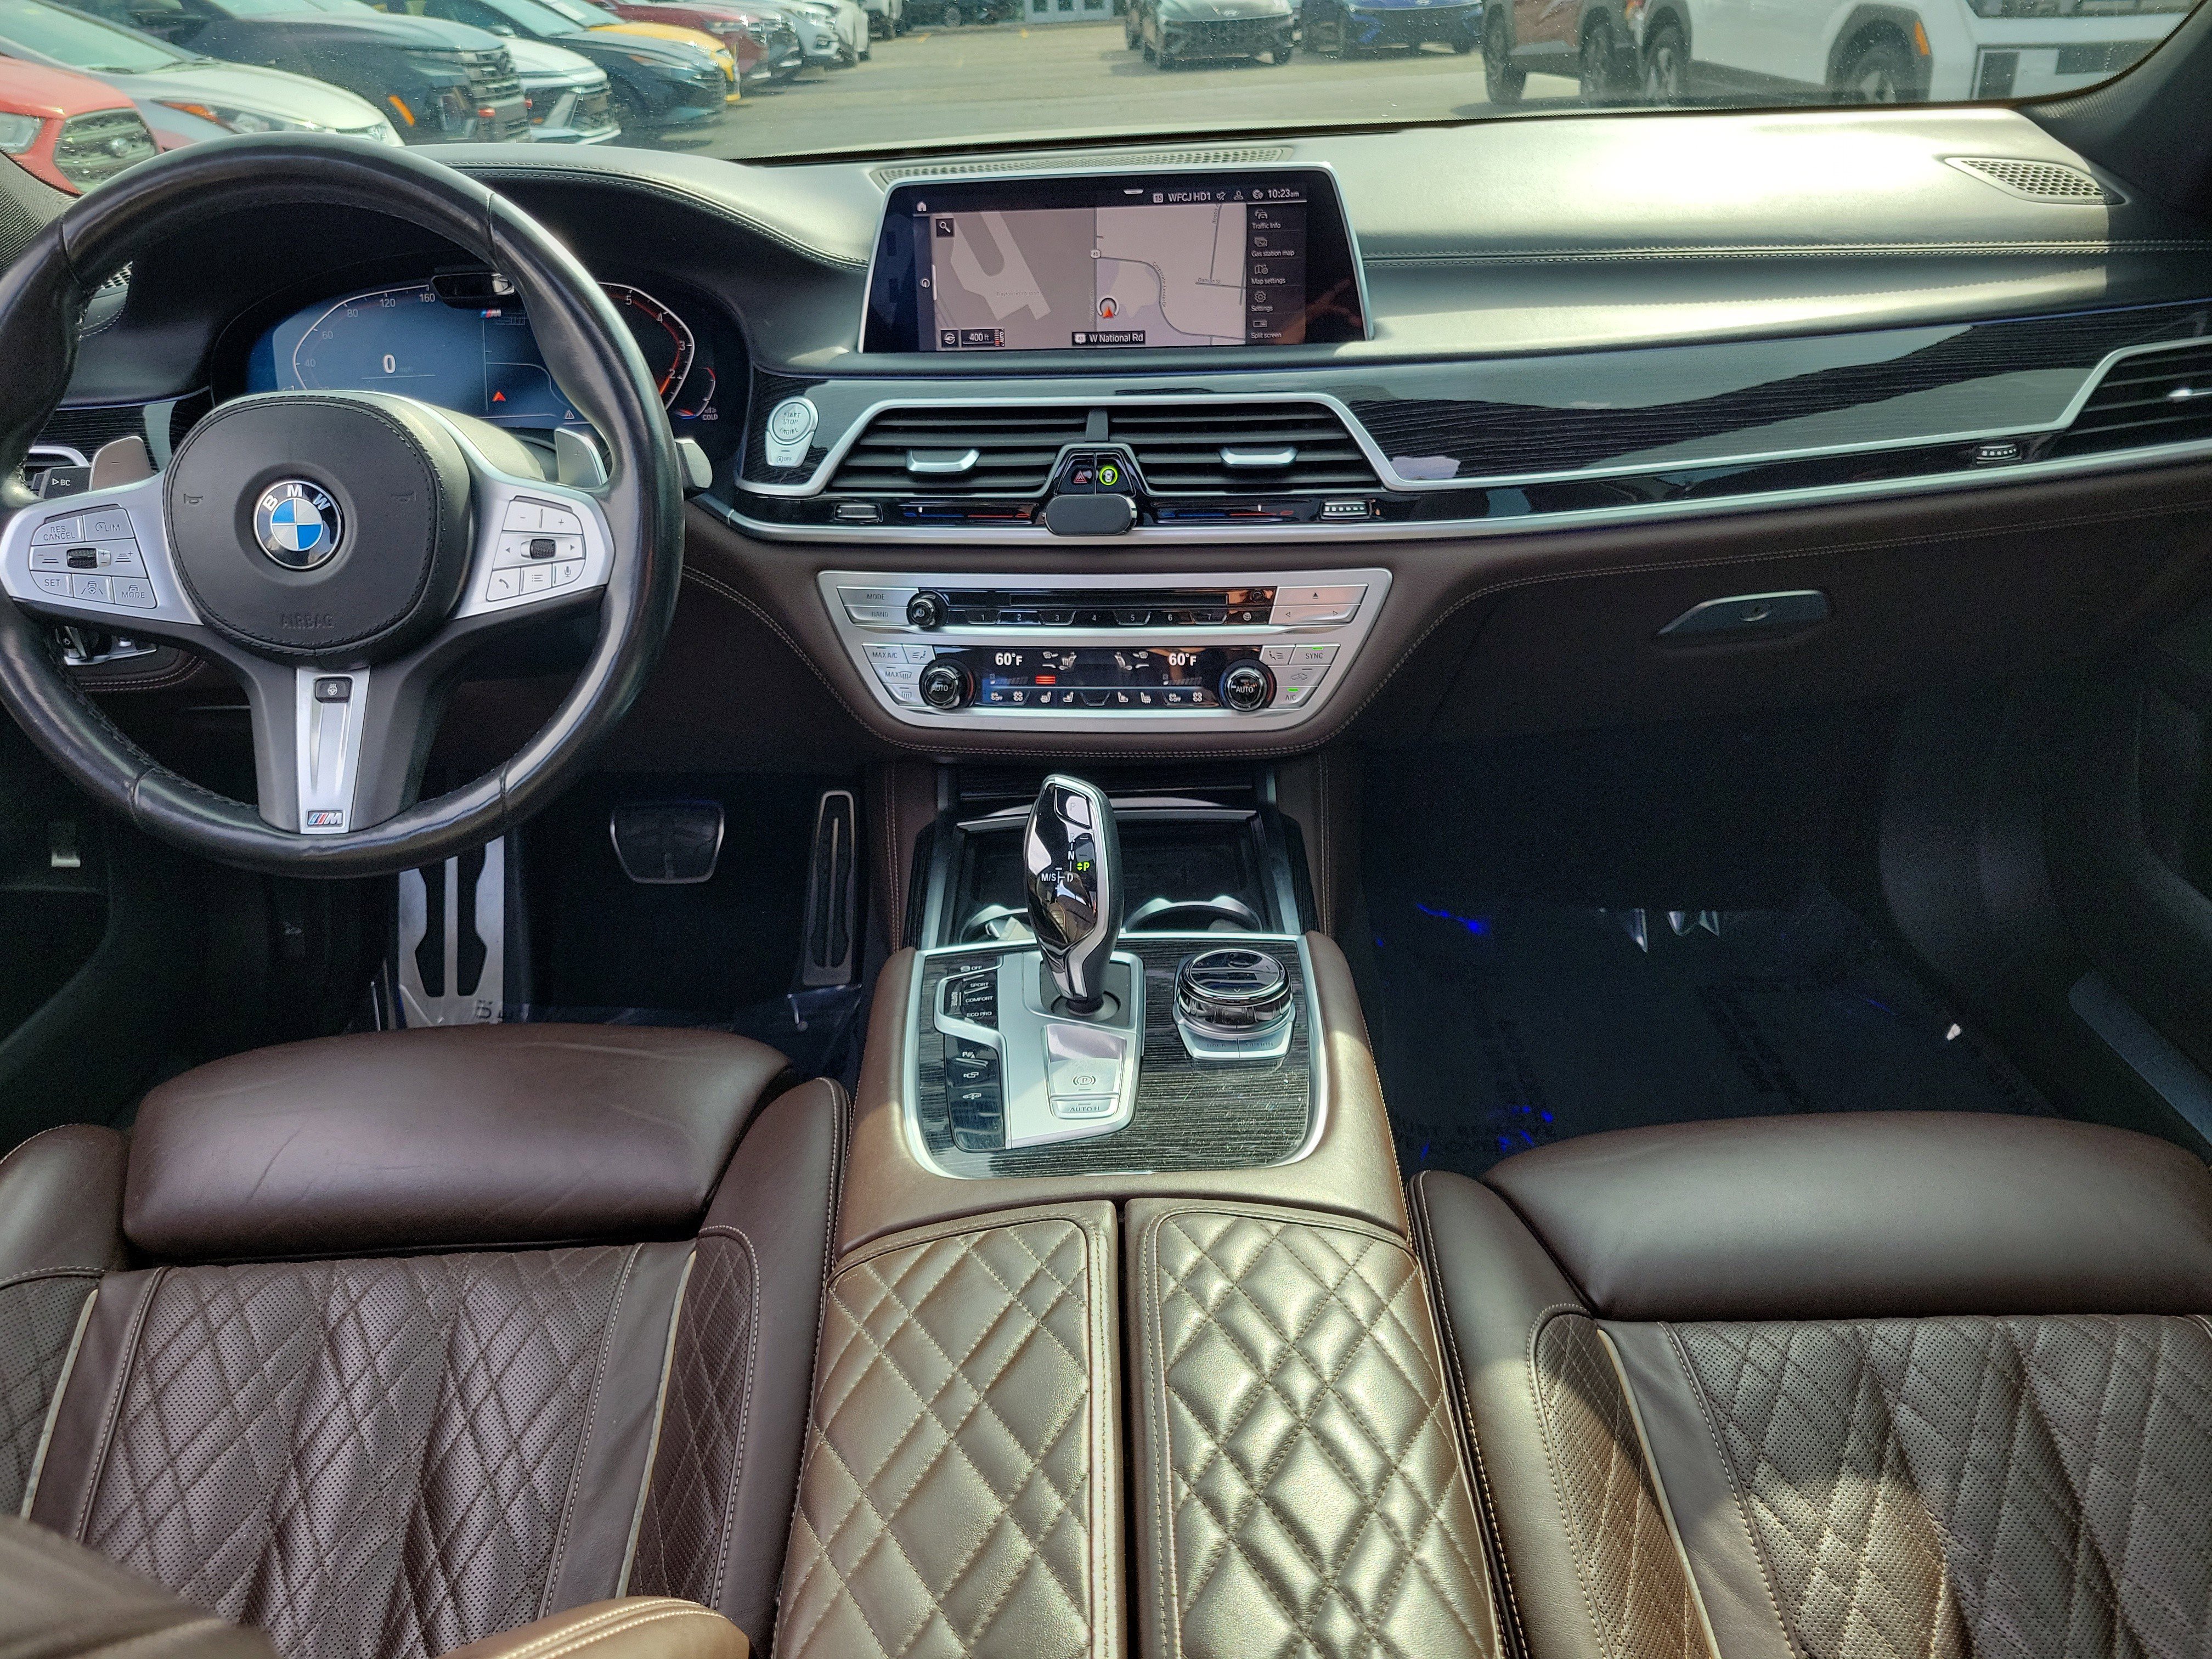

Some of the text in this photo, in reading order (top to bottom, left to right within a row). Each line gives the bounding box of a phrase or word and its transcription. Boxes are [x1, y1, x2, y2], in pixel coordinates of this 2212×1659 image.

[1168, 194, 1192, 202] WFCJ
[1195, 193, 1211, 201] HD1
[380, 298, 396, 308] 120
[419, 294, 436, 302] 160
[625, 296, 632, 306] 5
[347, 309, 358, 318] 80
[1251, 305, 1273, 313] Settings
[657, 313, 663, 323] 4
[321, 331, 334, 340] 60
[969, 332, 983, 341] 400
[1088, 334, 1098, 343] W
[1099, 334, 1131, 342] National
[1132, 333, 1143, 342] Rd
[1251, 332, 1263, 340] Split
[679, 341, 686, 351] 3
[304, 359, 316, 368] 40
[383, 354, 396, 374] 0
[668, 369, 676, 379] 2
[262, 484, 331, 511] BMW
[50, 525, 66, 533] RES
[105, 523, 121, 532] LIM
[43, 532, 76, 541] CANCEL
[44, 579, 61, 587] SET
[995, 652, 1023, 666] 60°F
[1168, 652, 1197, 667] 60°F
[1068, 850, 1075, 860] N
[1084, 861, 1091, 871] P
[1041, 872, 1074, 882] M/S D
